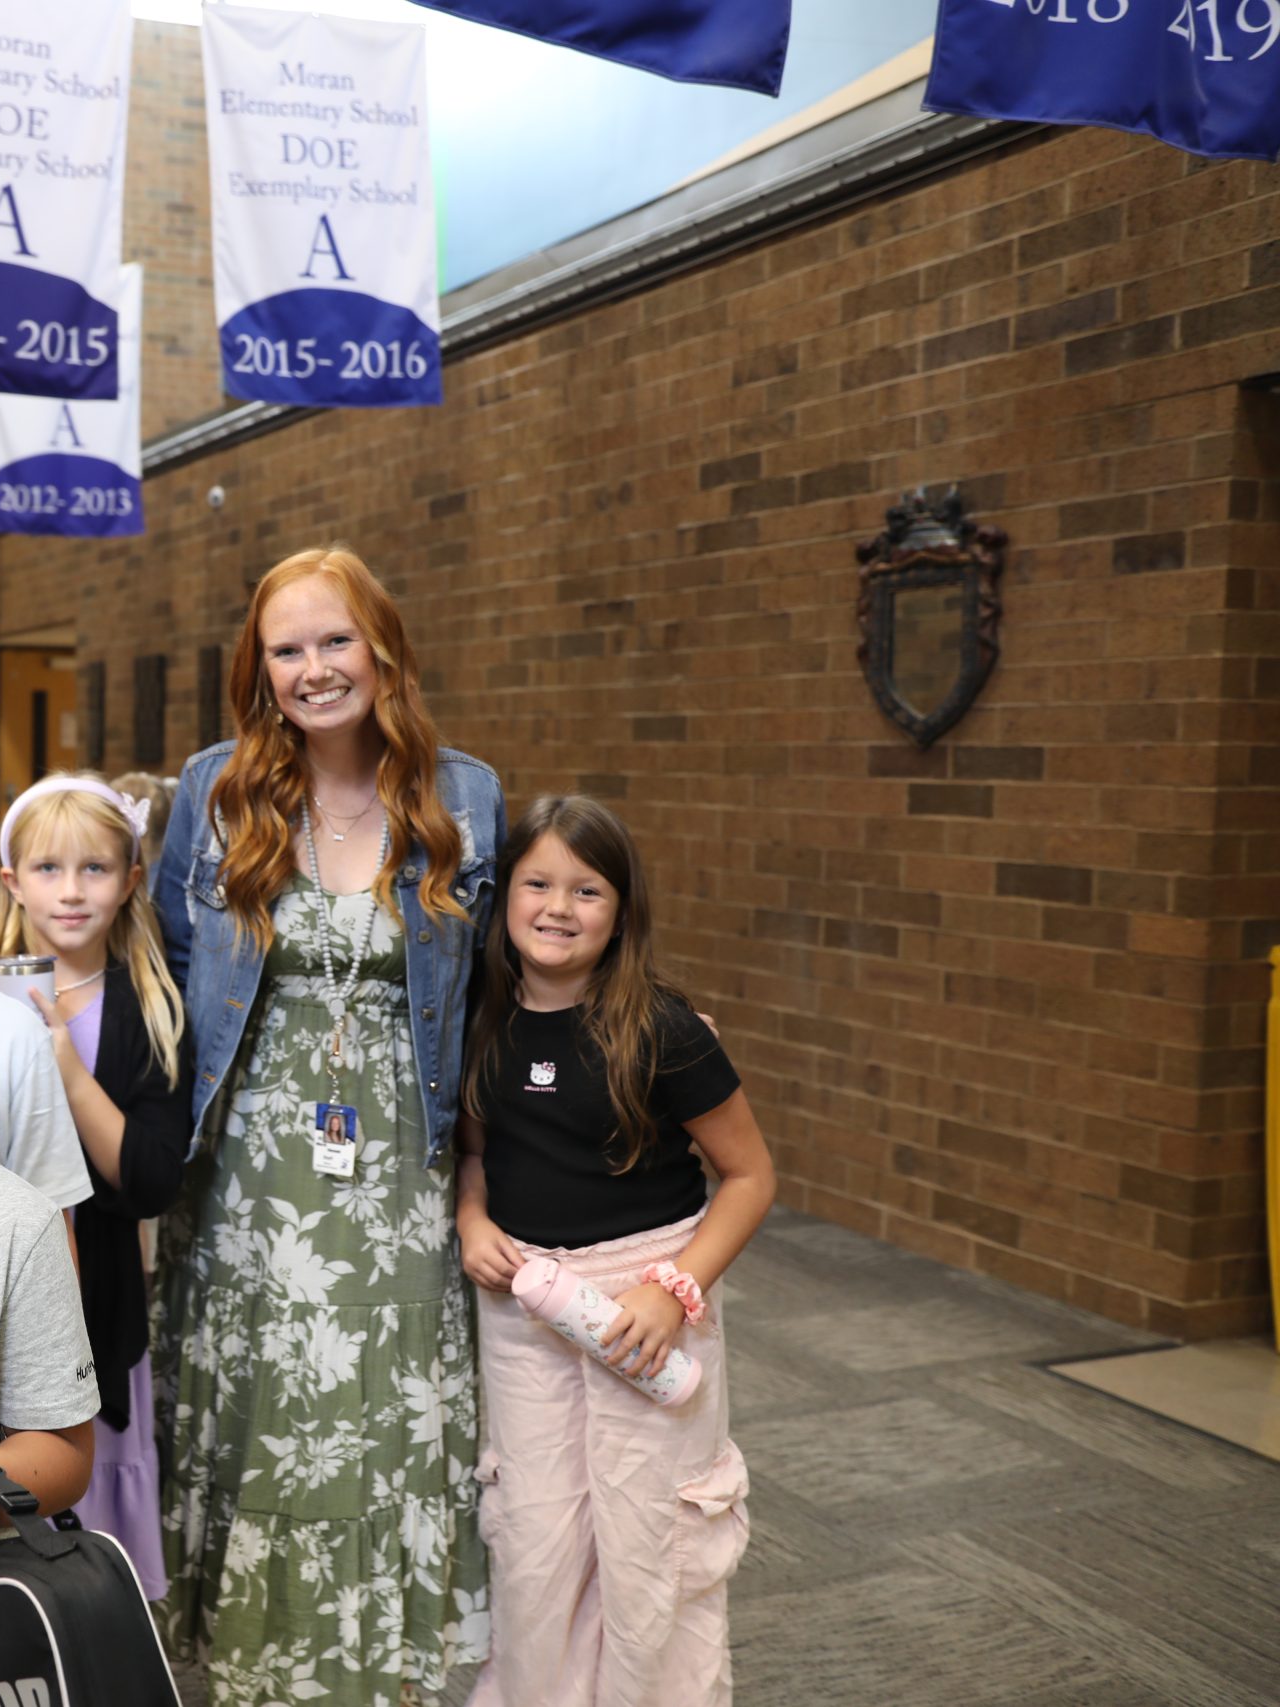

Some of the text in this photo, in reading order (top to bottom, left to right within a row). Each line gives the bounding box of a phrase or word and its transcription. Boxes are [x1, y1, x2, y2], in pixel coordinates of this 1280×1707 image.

[43, 70, 120, 101] School
[279, 61, 356, 92] Moran
[220, 89, 418, 129] Elementary School
[36, 150, 113, 180] School
[281, 133, 360, 170] DOE
[228, 173, 417, 208] Exemplary School
[299, 214, 356, 281] A
[49, 402, 83, 447] A
